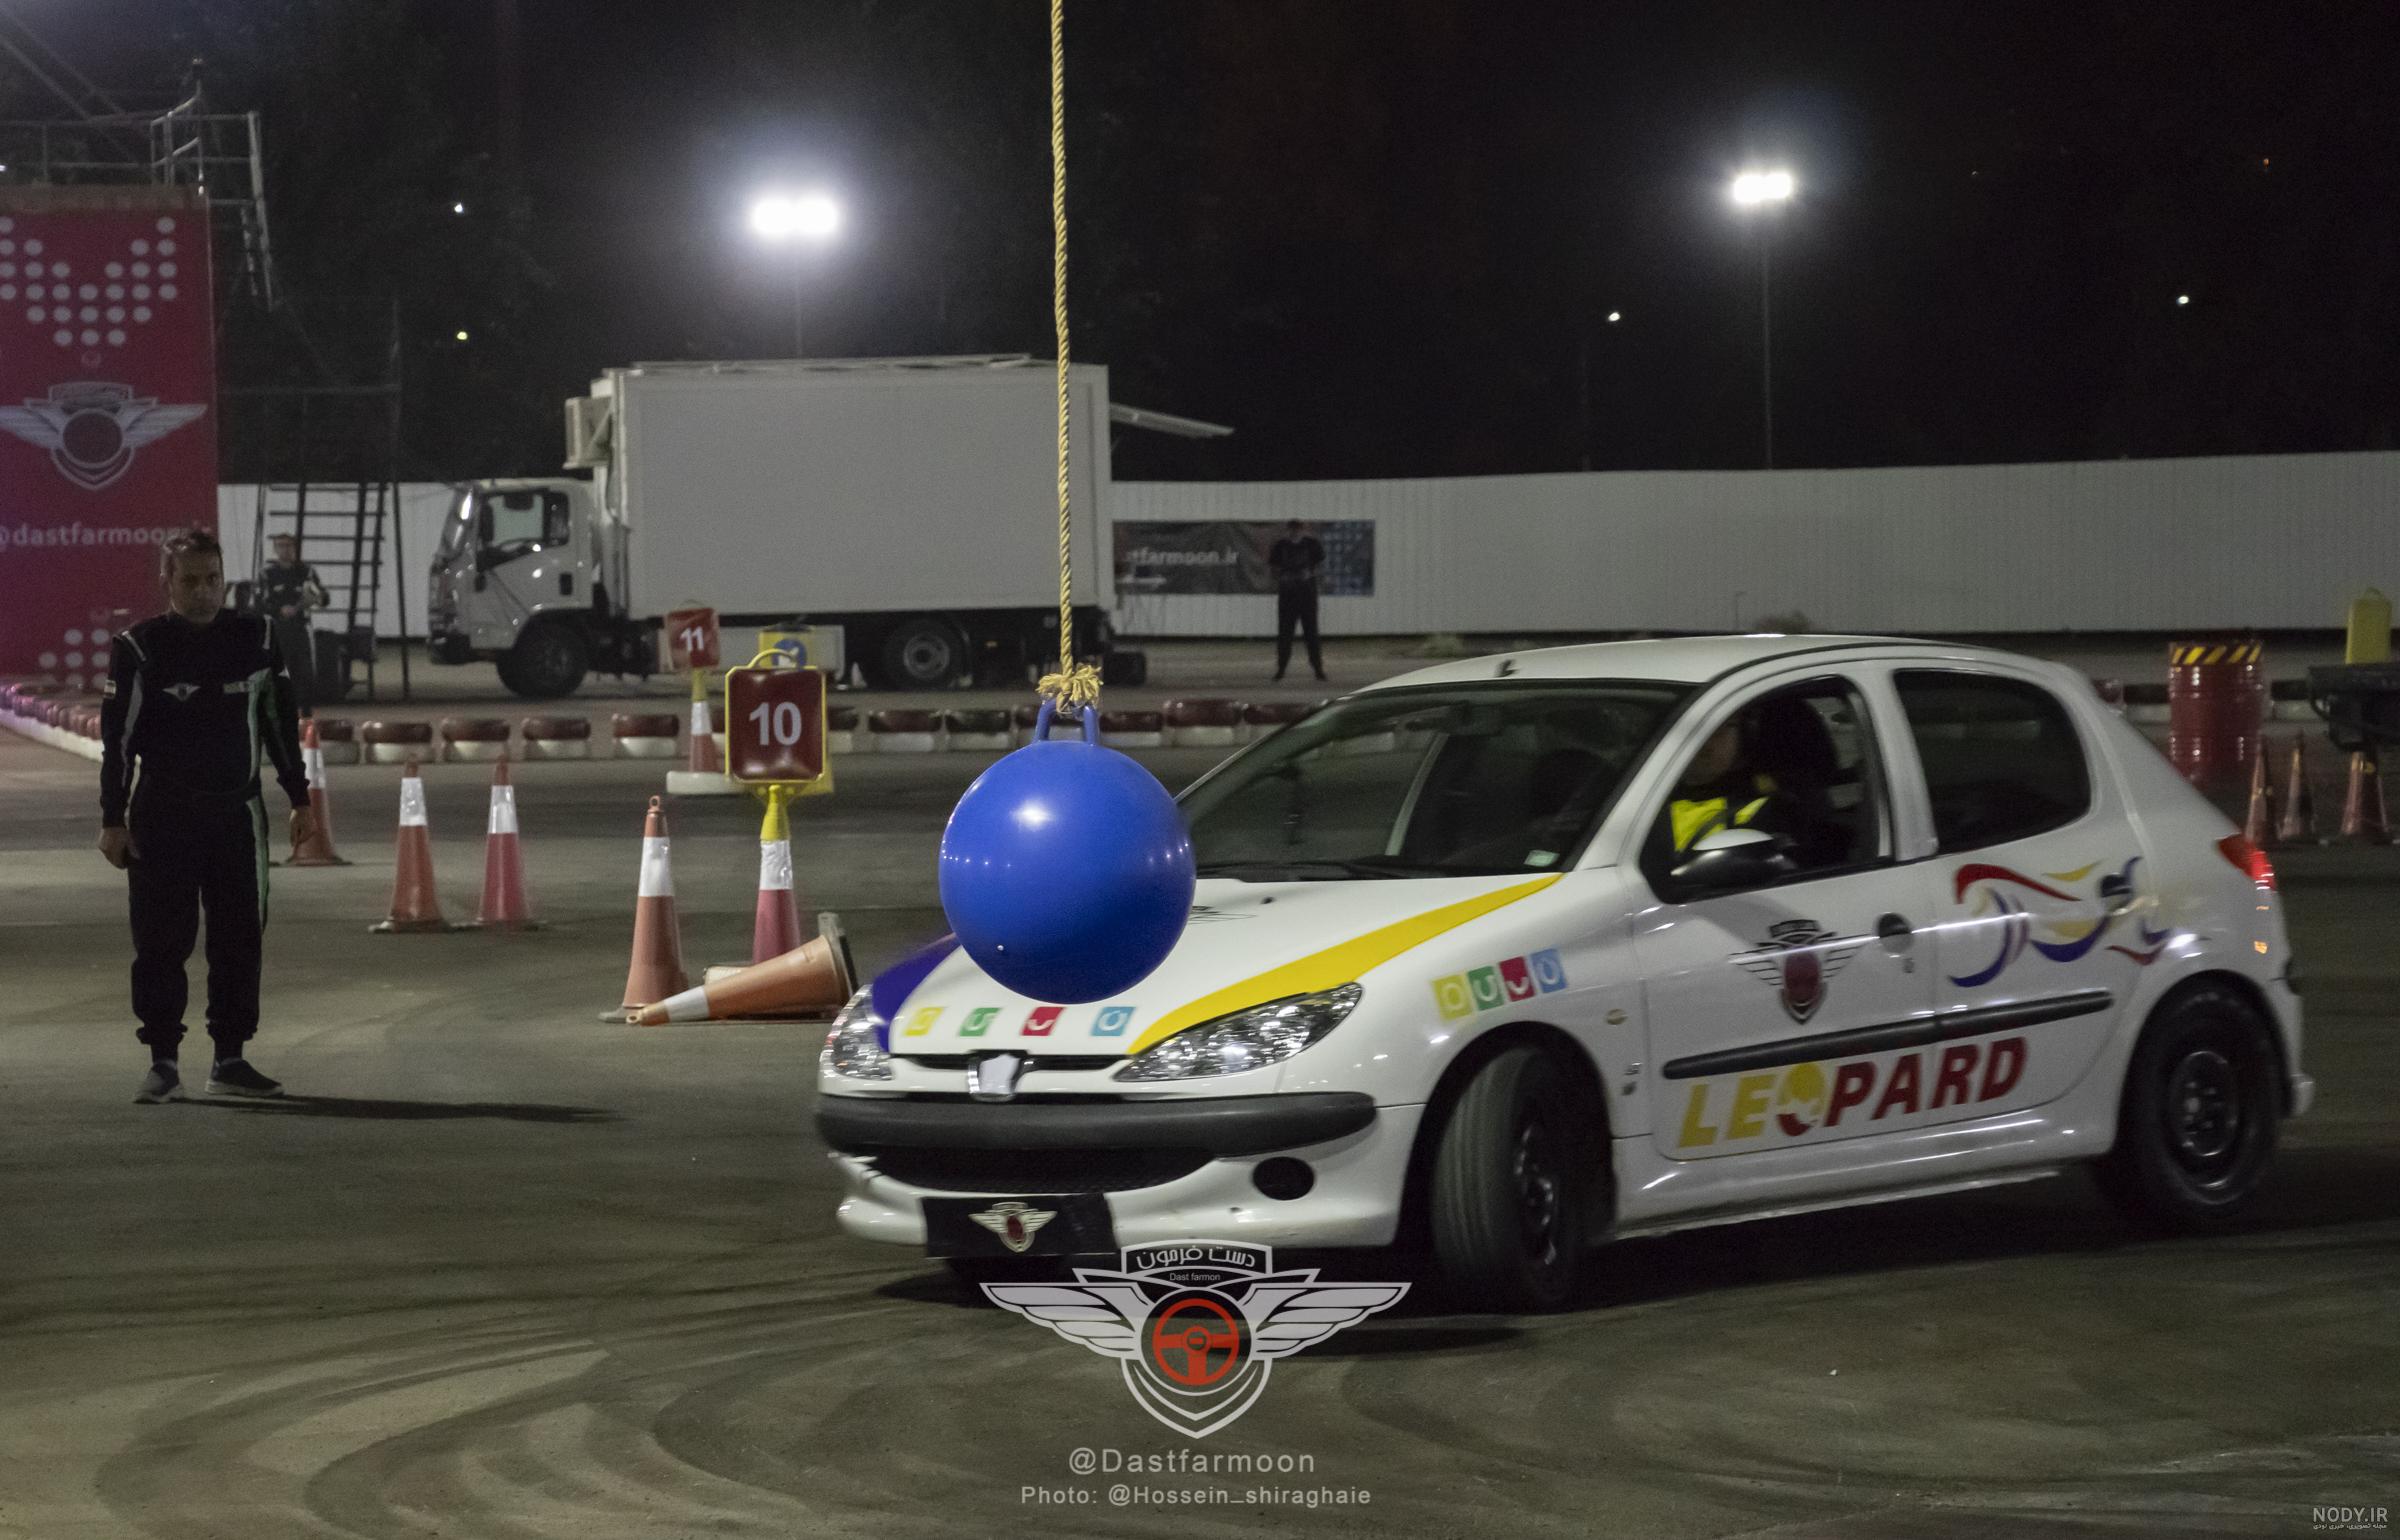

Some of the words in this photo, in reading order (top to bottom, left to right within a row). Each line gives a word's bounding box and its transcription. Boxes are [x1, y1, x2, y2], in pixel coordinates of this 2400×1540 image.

[680, 626, 705, 651] 11
[749, 701, 802, 746] 10
[1678, 1036, 2027, 1148] LEOPARD
